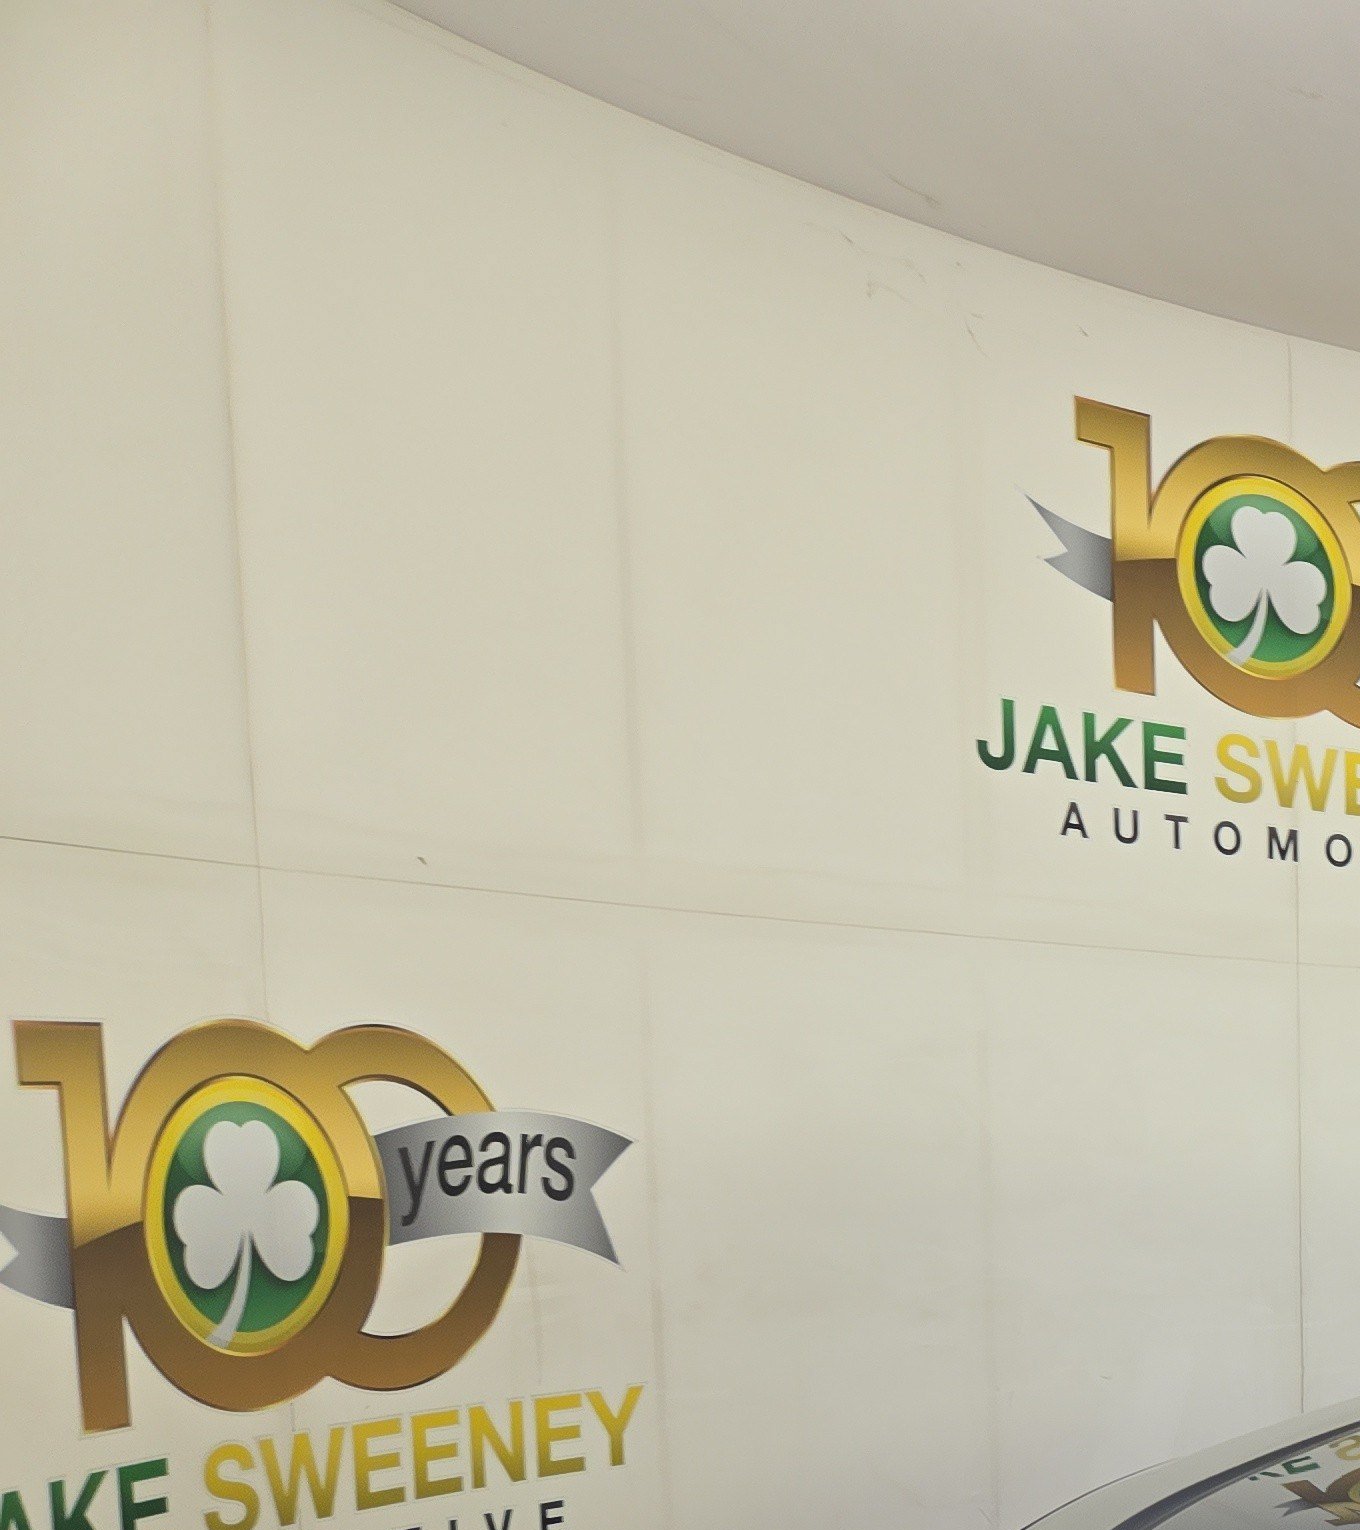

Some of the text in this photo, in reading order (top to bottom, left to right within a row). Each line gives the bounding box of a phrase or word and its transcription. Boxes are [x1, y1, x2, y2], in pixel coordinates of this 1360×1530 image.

[975, 697, 1189, 795] JAKE
[12, 1018, 522, 1432] 100
[398, 1130, 577, 1226] years
